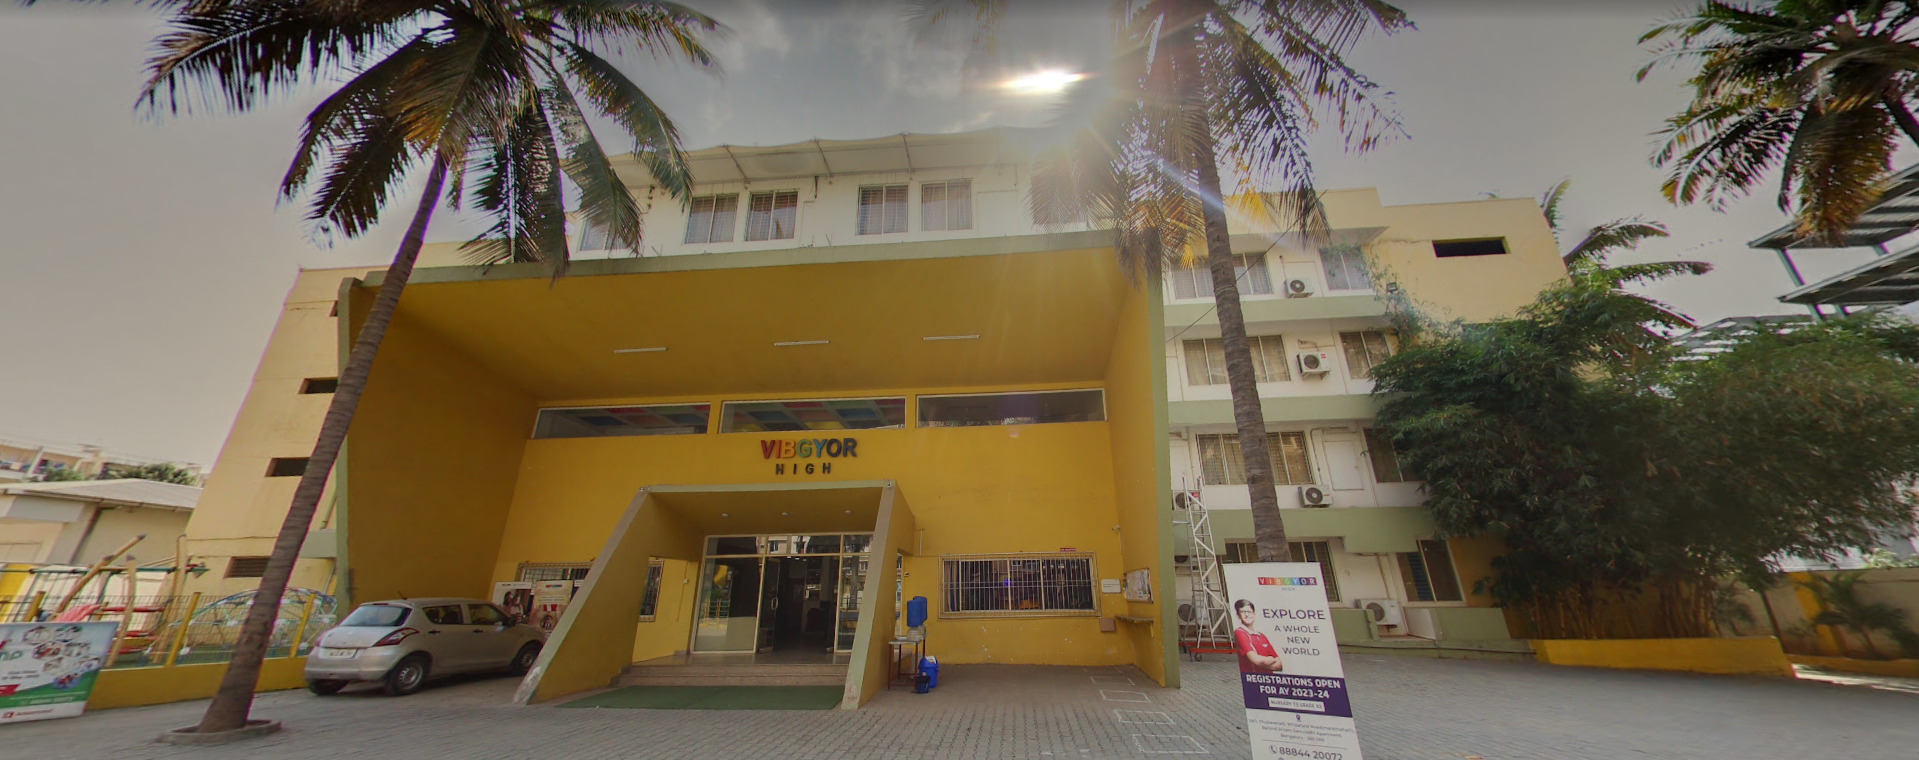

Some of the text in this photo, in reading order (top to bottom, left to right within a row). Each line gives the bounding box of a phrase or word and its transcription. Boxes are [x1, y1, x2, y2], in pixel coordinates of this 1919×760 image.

[761, 438, 858, 459] VIBGYOR
[776, 462, 832, 474] HIGH
[1259, 577, 1316, 586] VIBGYOR
[1262, 608, 1326, 620] EXPLORE
[1283, 625, 1320, 634] WHOLE
[1282, 647, 1320, 656] WORLD
[1246, 674, 1340, 688] REGISTRATIONS OPEN
[1260, 686, 1330, 699] FOR AY 2023-24
[1279, 747, 1310, 757] 88844
